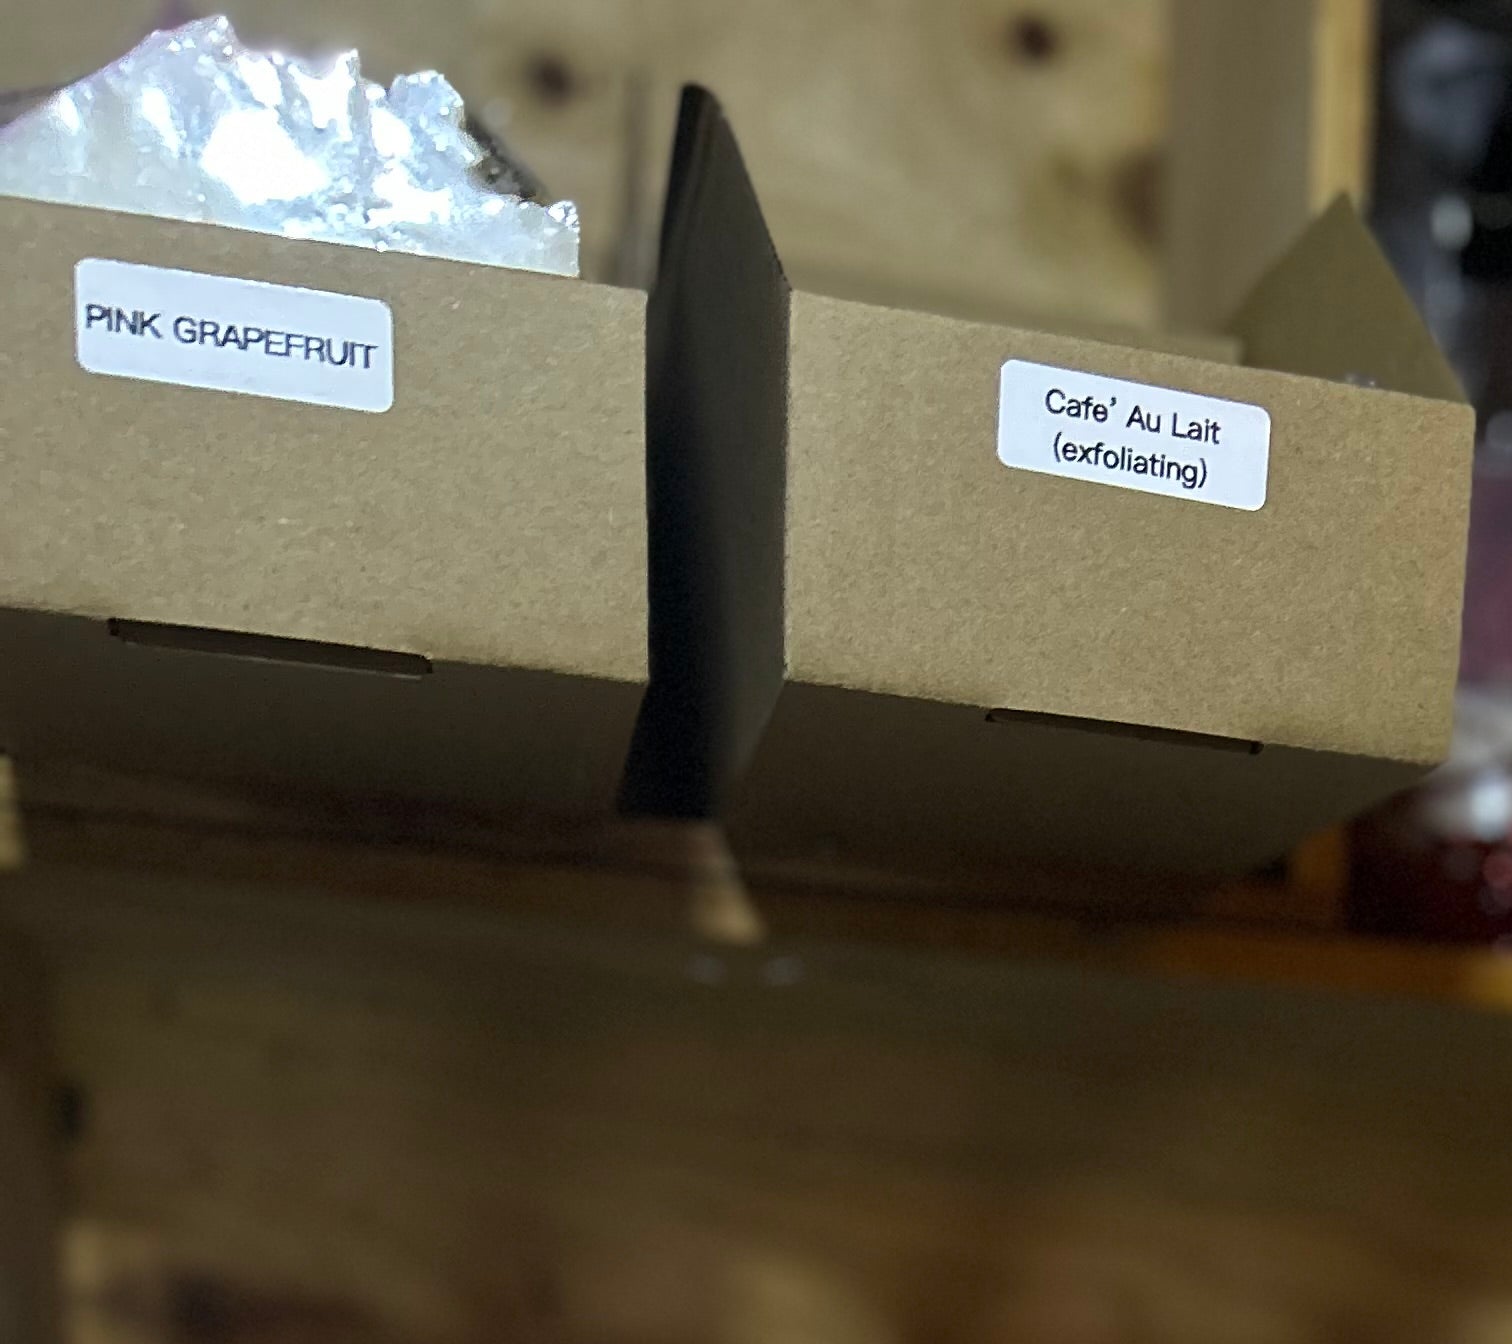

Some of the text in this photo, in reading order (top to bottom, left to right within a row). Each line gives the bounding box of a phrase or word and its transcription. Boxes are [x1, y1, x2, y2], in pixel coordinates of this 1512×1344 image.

[85, 303, 379, 369] PINK GRAPEFRUIT
[1126, 405, 1162, 433] Au
[1172, 413, 1221, 444] Lait
[1053, 431, 1208, 489] (exfoliating)
